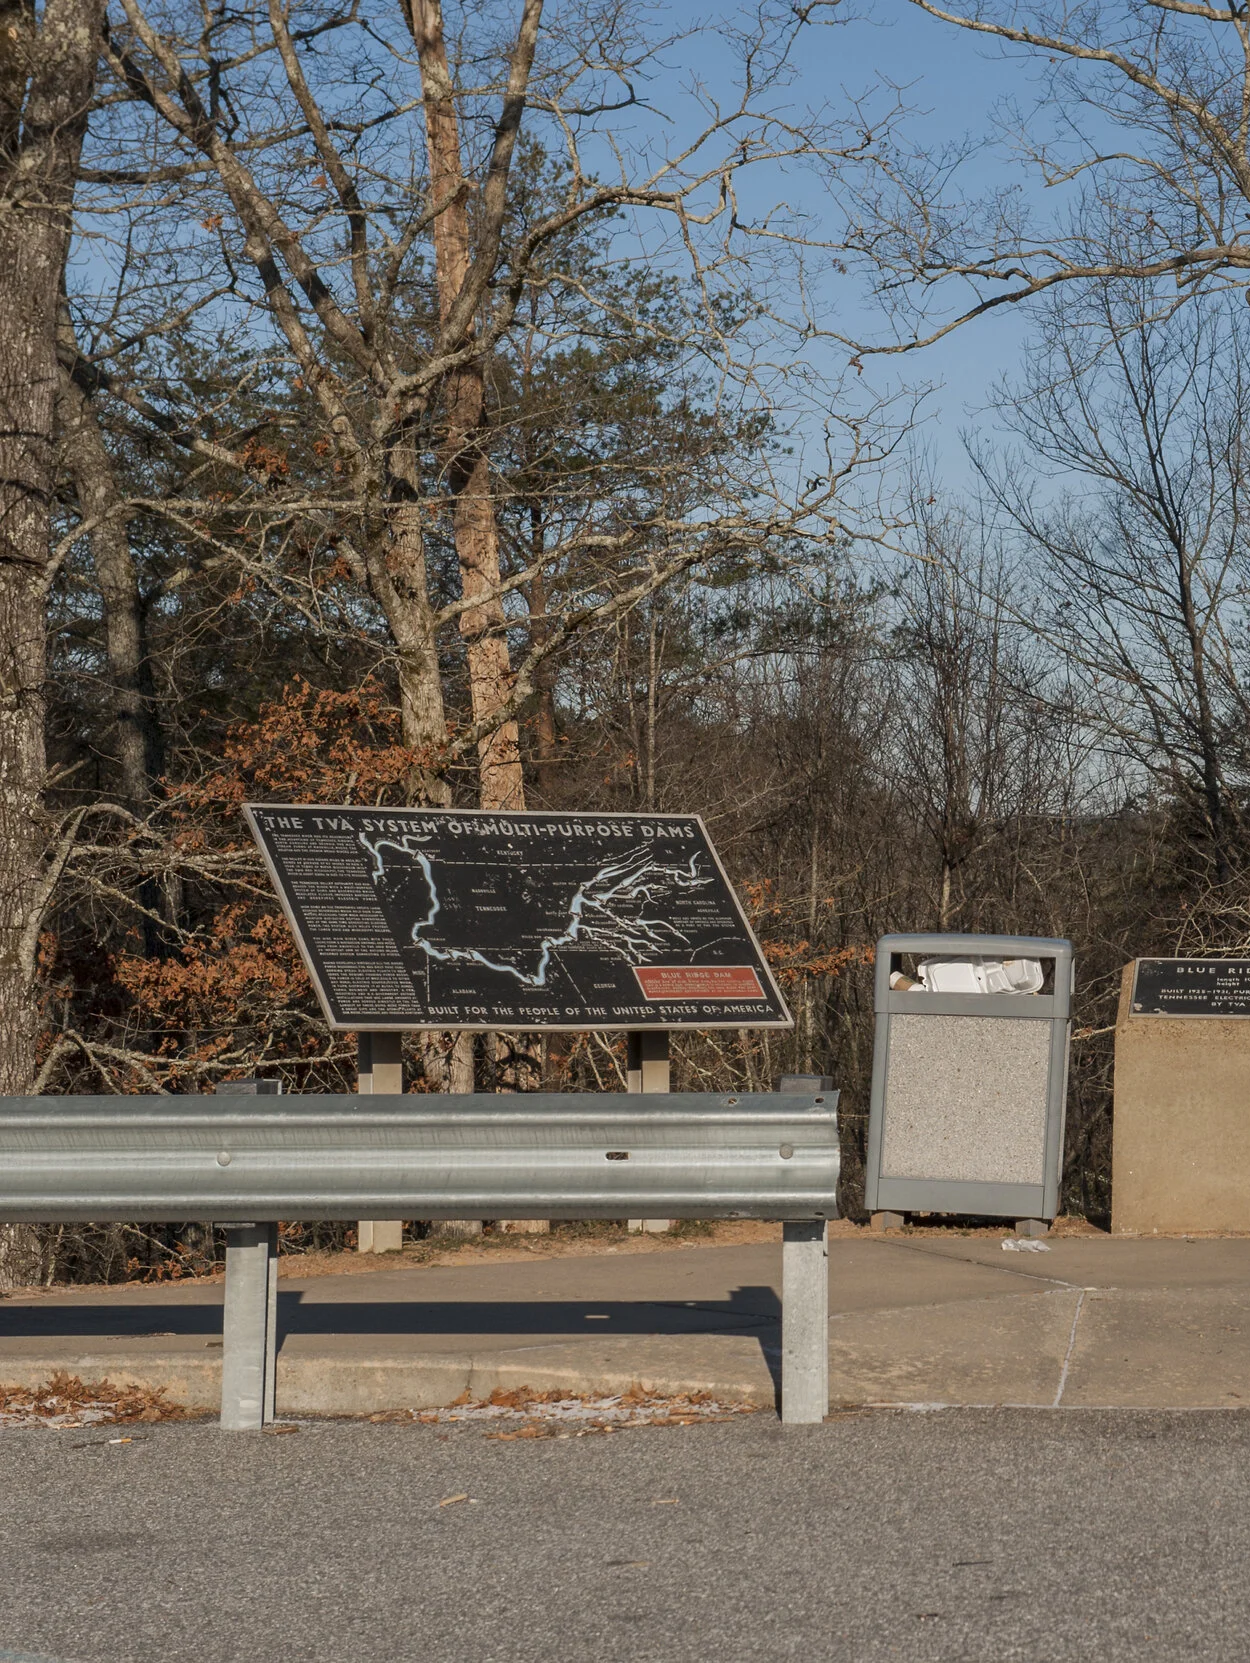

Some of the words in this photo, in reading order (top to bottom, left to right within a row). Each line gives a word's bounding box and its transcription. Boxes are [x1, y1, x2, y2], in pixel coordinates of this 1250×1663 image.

[266, 816, 303, 830] THE
[312, 817, 354, 830] TVA
[362, 818, 438, 833] SYSTEM
[448, 821, 473, 834] OF
[486, 822, 634, 836] MULTI-PURPOSE
[640, 825, 695, 838] DAMS
[428, 1006, 459, 1015] BUILT
[464, 1006, 488, 1015] FOR
[492, 1007, 515, 1015] THE
[519, 1007, 560, 1015] PEOPLE
[565, 1007, 581, 1015] OF
[585, 1007, 607, 1015] THE
[613, 1006, 654, 1015] UNITED
[660, 1006, 698, 1014] STATES
[724, 1005, 774, 1013] AMERICA
